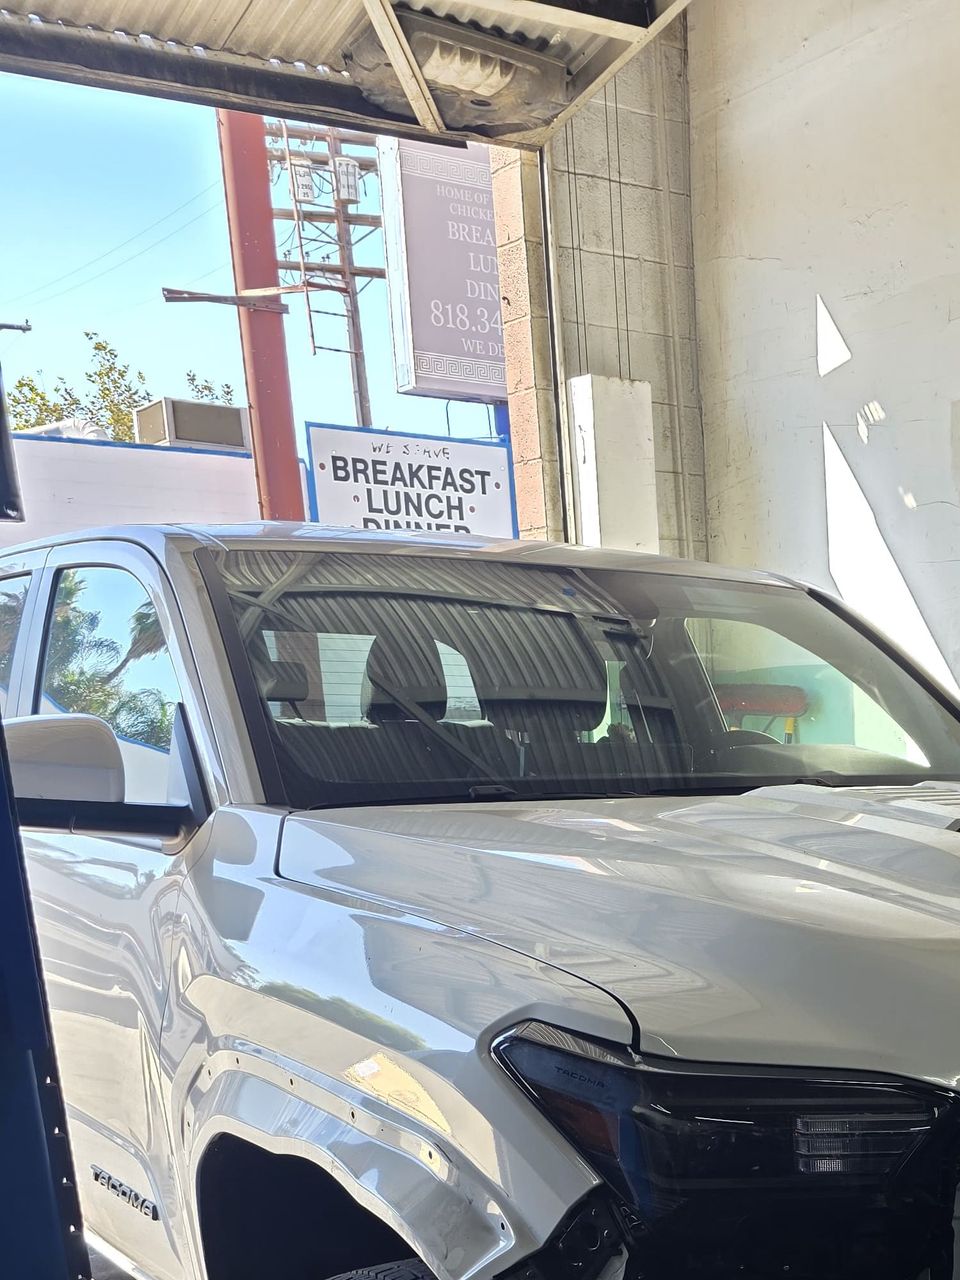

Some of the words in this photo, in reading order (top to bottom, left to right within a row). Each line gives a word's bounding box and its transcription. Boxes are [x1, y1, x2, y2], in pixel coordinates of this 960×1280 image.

[436, 184, 473, 202] HOME
[474, 192, 490, 205] OF
[447, 220, 496, 247] BREA
[431, 299, 503, 336] 818.34
[461, 338, 485, 354] WE
[371, 441, 394, 454] WE
[331, 455, 491, 495] BREAKFAST
[366, 488, 465, 521] LUNCH
[554, 1066, 605, 1088] TACOMA
[90, 1163, 160, 1221] TACOMA
